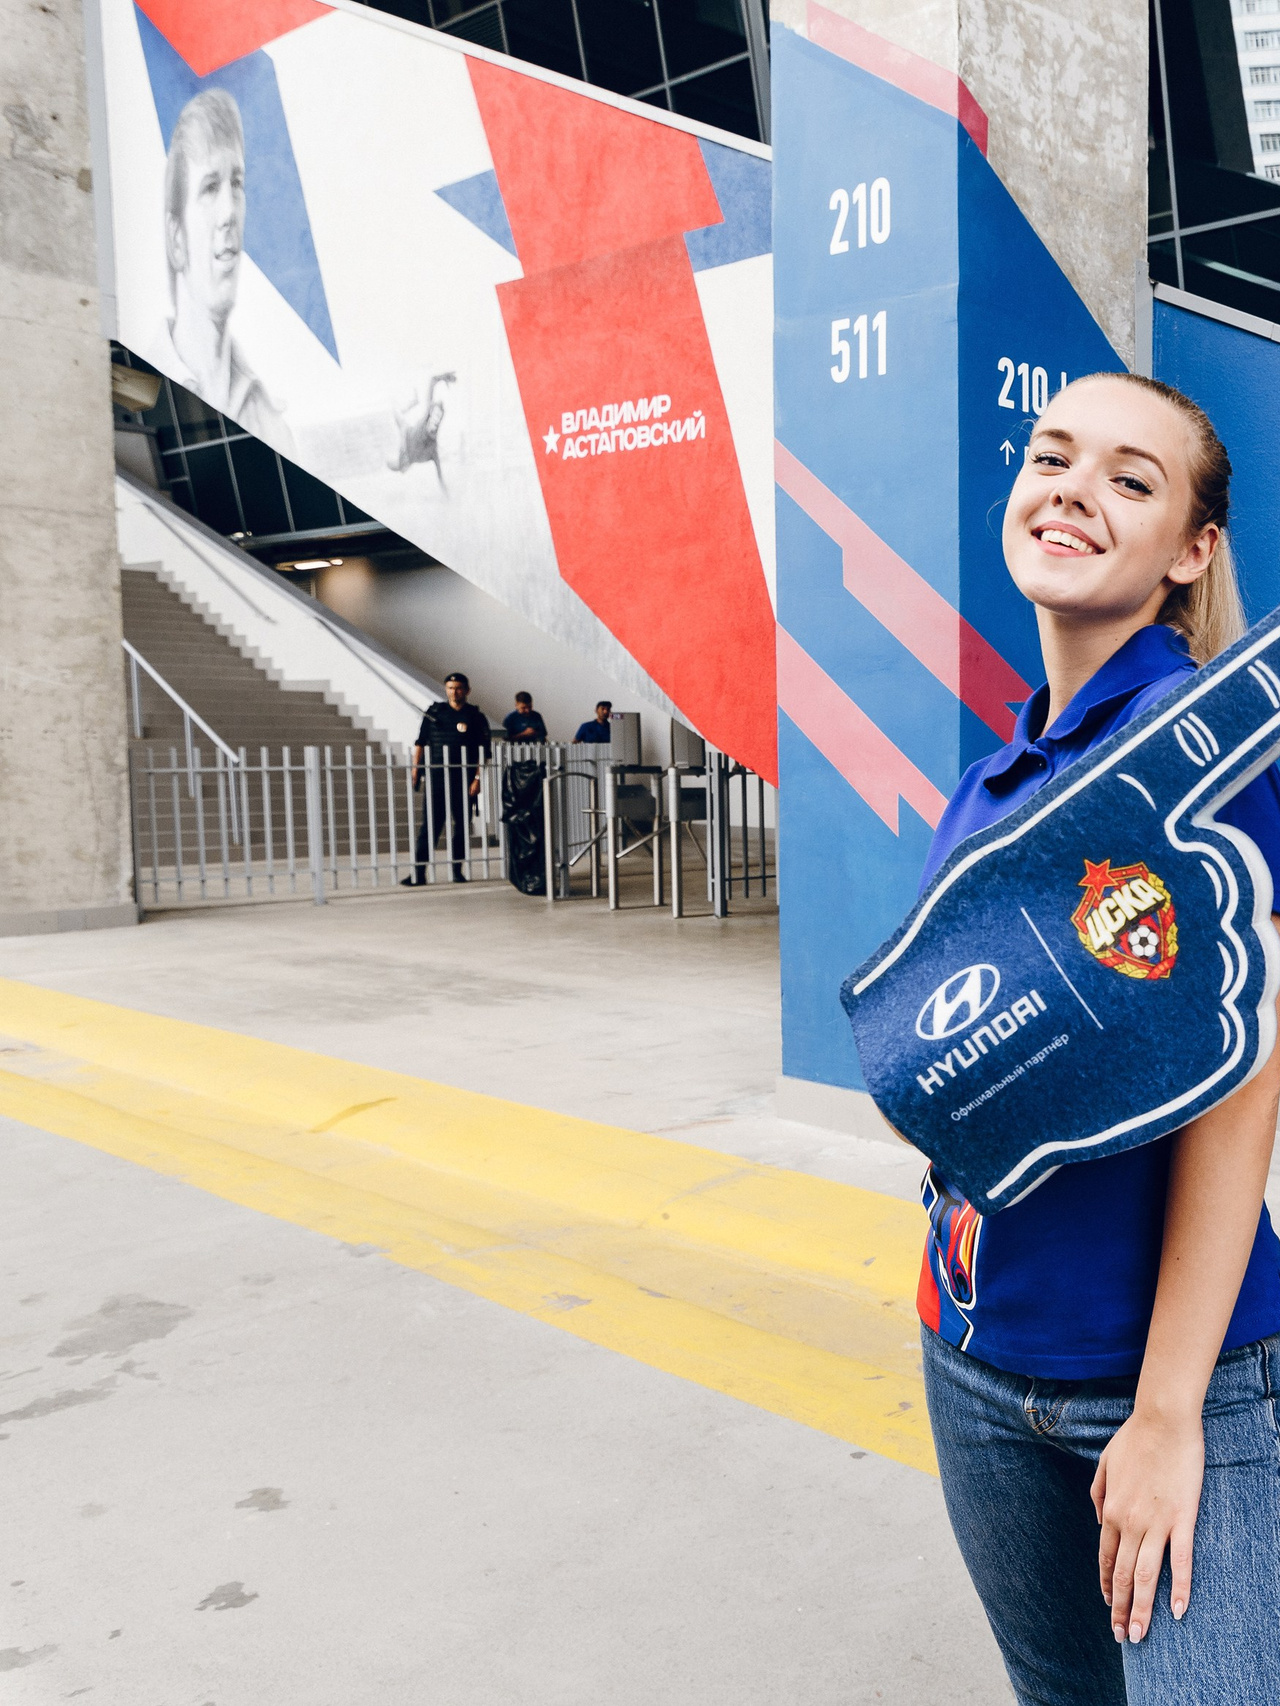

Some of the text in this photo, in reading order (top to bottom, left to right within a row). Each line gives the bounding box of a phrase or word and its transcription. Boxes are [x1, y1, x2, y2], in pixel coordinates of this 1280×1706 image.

[828, 176, 891, 256] 210
[830, 310, 887, 384] 511
[561, 394, 672, 435] ВЛАДИМИР
[997, 356, 1049, 417] 210
[562, 410, 706, 460] АСТАПОВСКИЙ
[1085, 878, 1166, 951] ЦСКА
[916, 989, 1047, 1096] HYUNDAI
[950, 1033, 1070, 1121] Официальный партнёр
